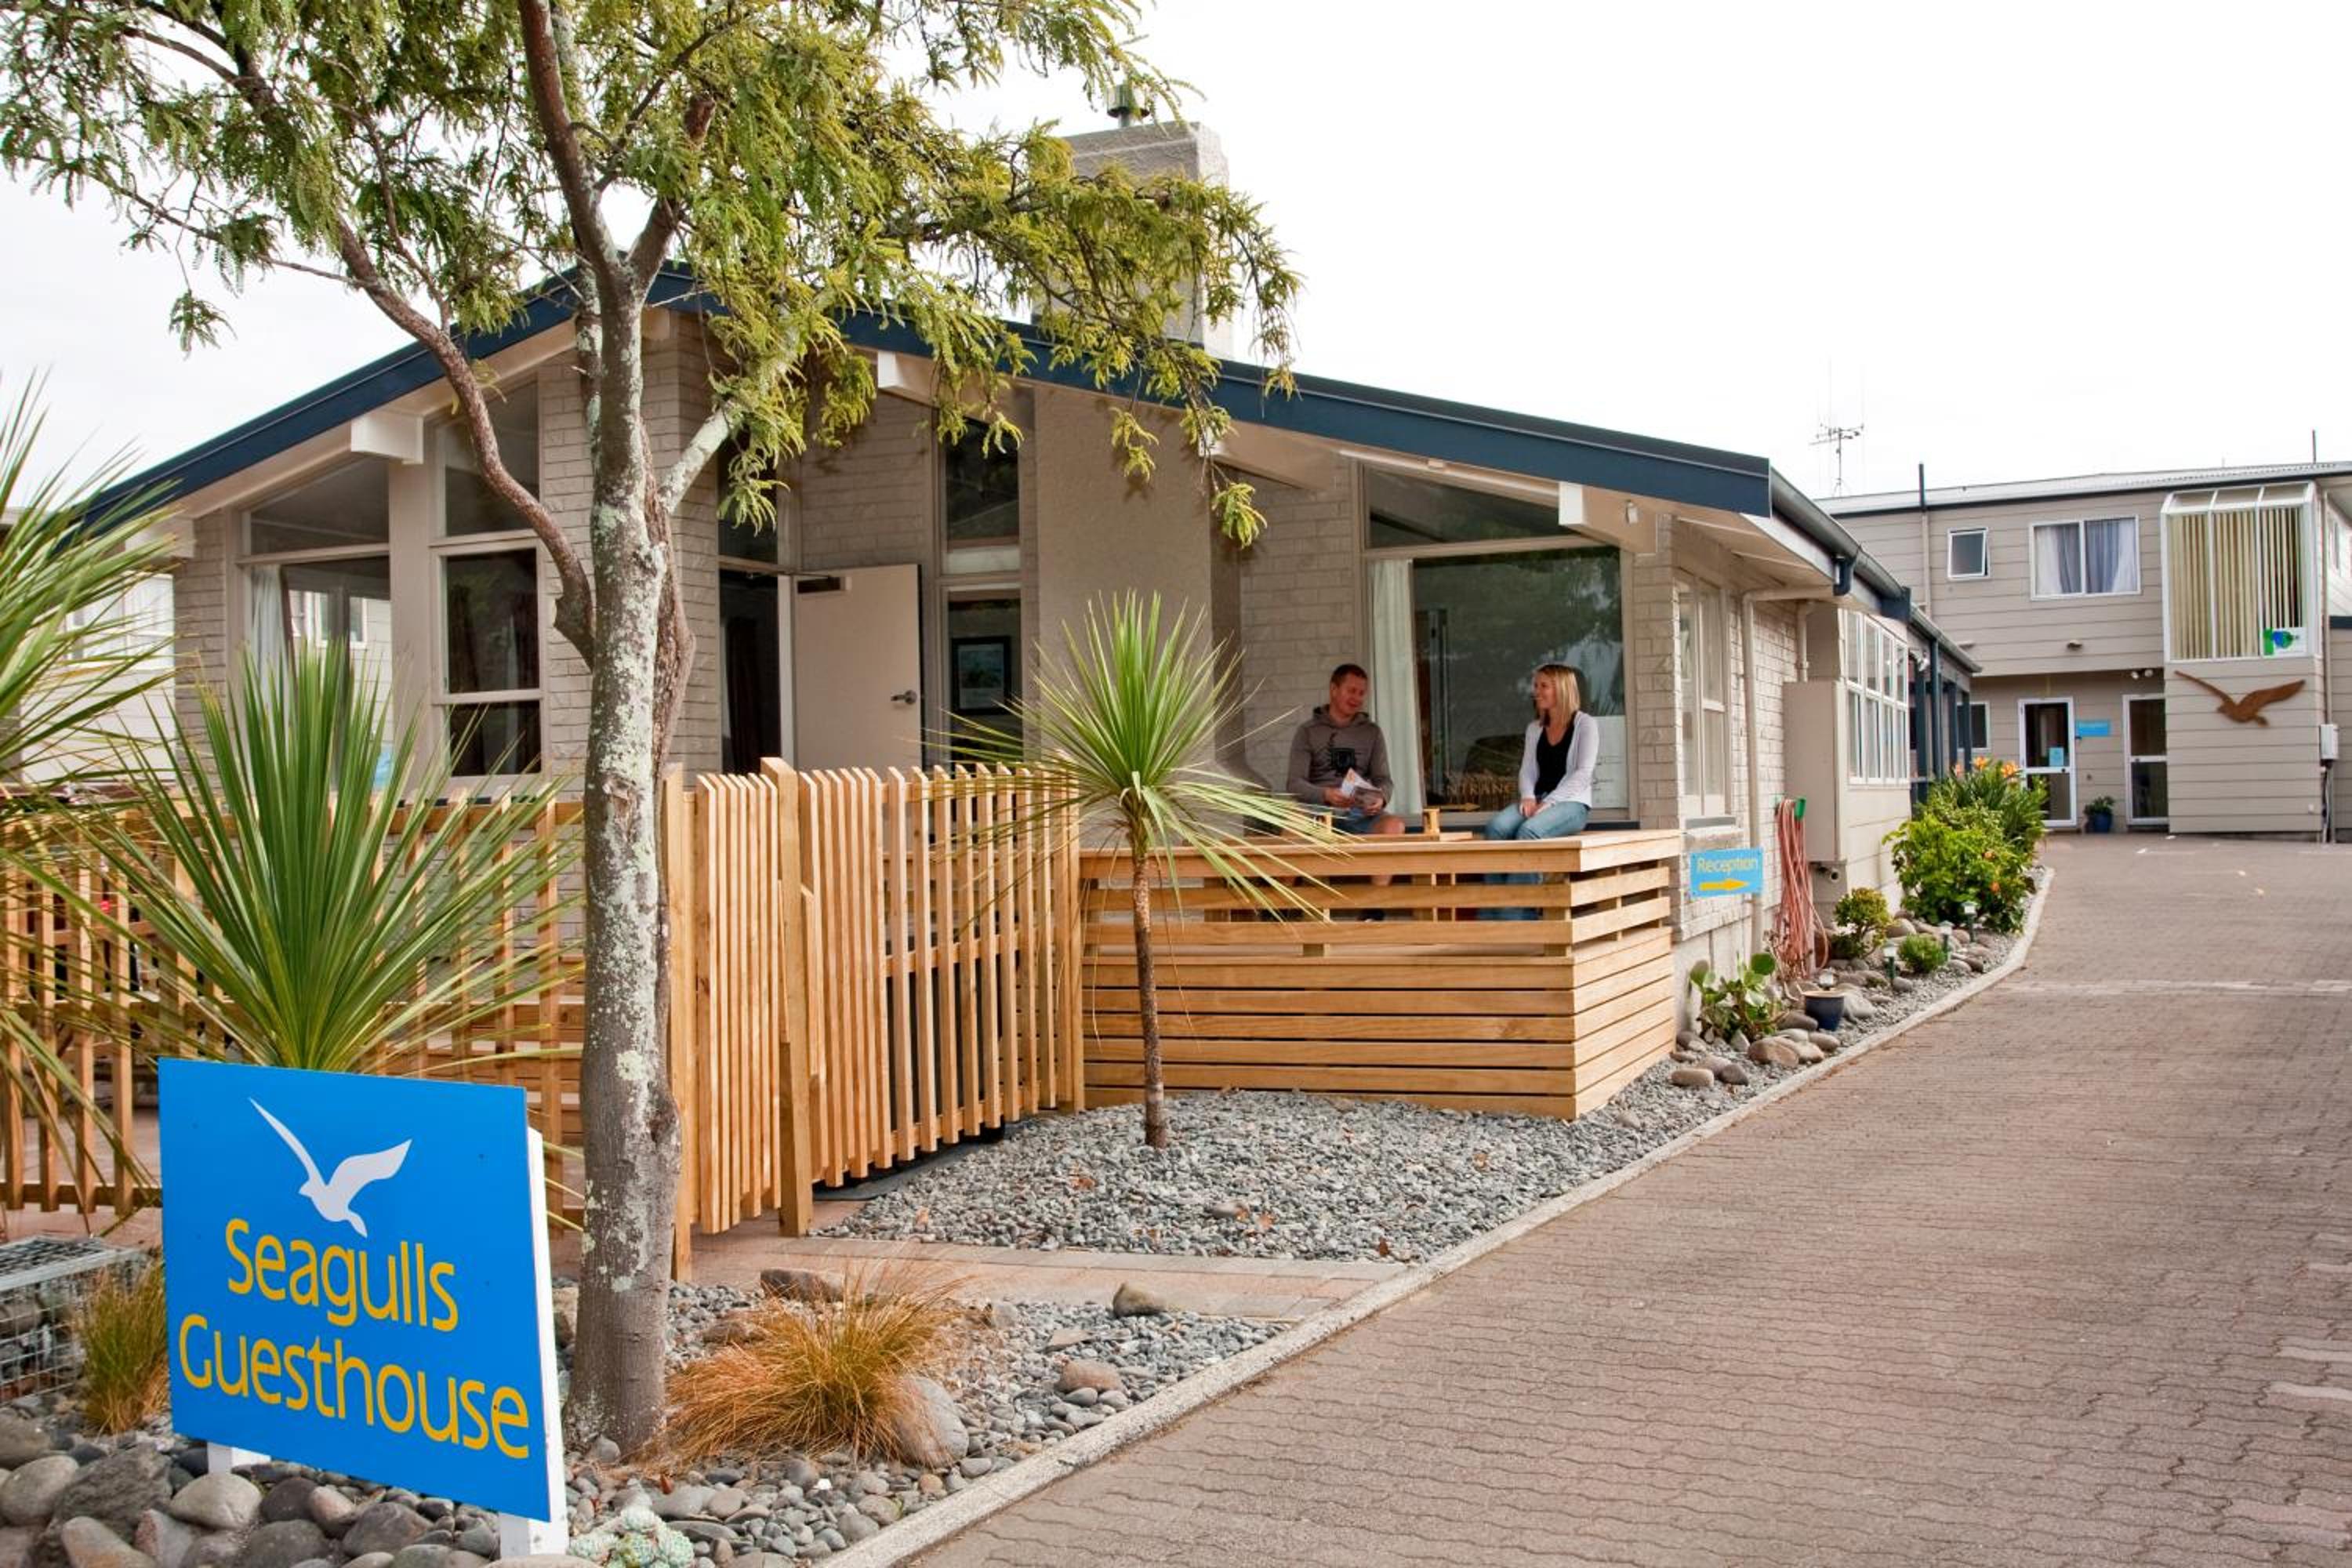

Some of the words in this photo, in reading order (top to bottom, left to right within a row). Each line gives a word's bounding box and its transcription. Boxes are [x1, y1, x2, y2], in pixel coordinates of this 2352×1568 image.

[1697, 857, 1758, 875] Reception
[225, 1218, 459, 1332] Seagulls
[179, 1314, 529, 1460] Guesthouse
